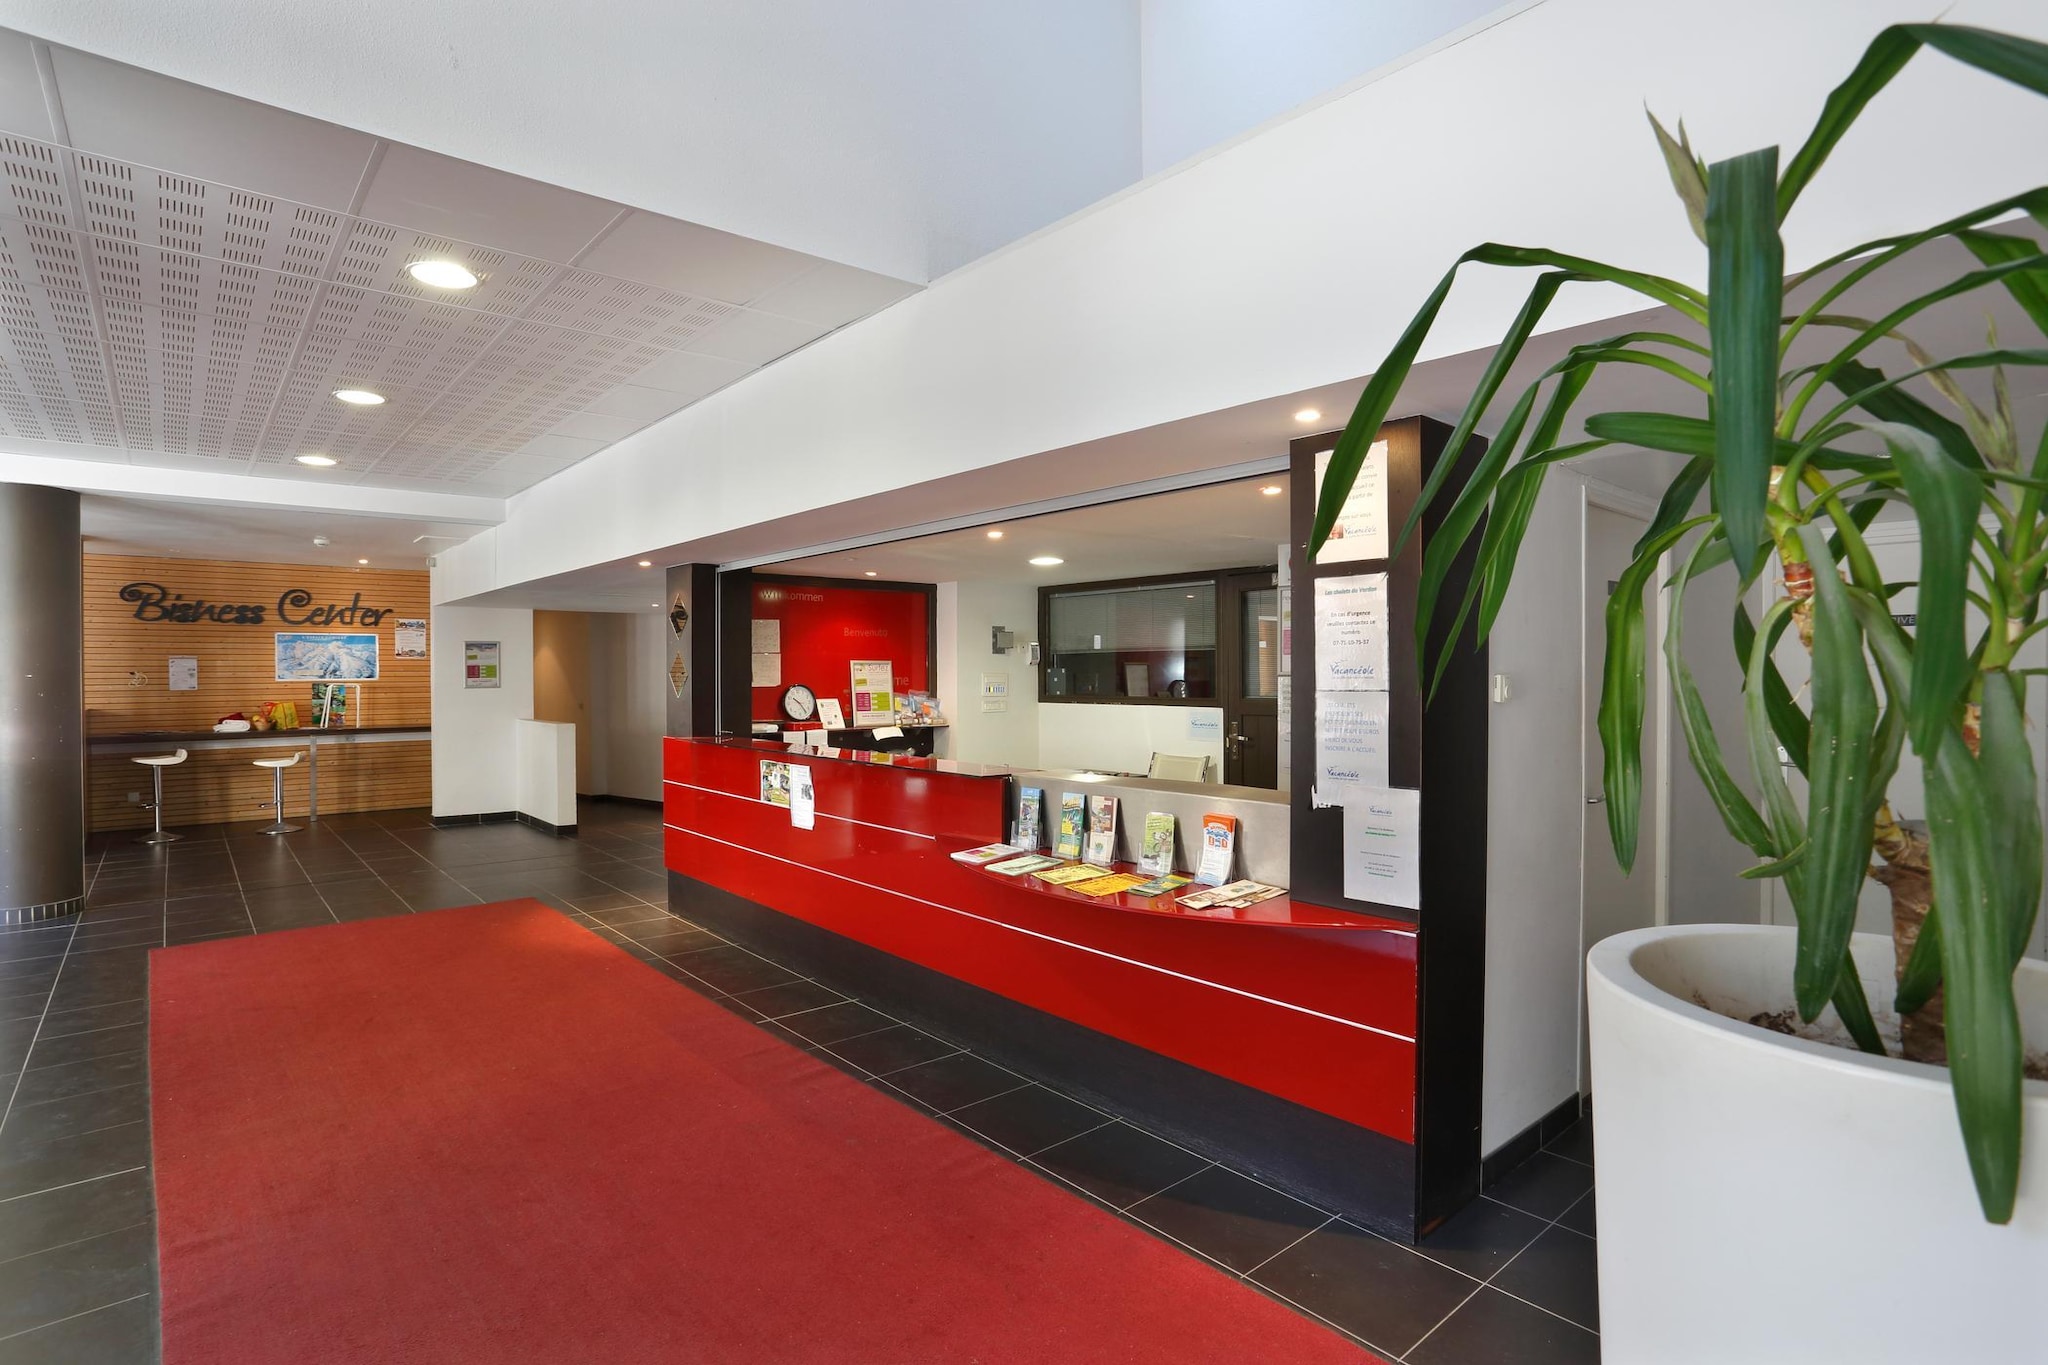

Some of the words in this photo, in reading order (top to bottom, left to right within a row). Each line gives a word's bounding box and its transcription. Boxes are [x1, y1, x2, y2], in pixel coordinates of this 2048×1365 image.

[119, 582, 267, 626] Bisness
[278, 588, 393, 627] Center
[843, 627, 888, 638] Benvenuto
